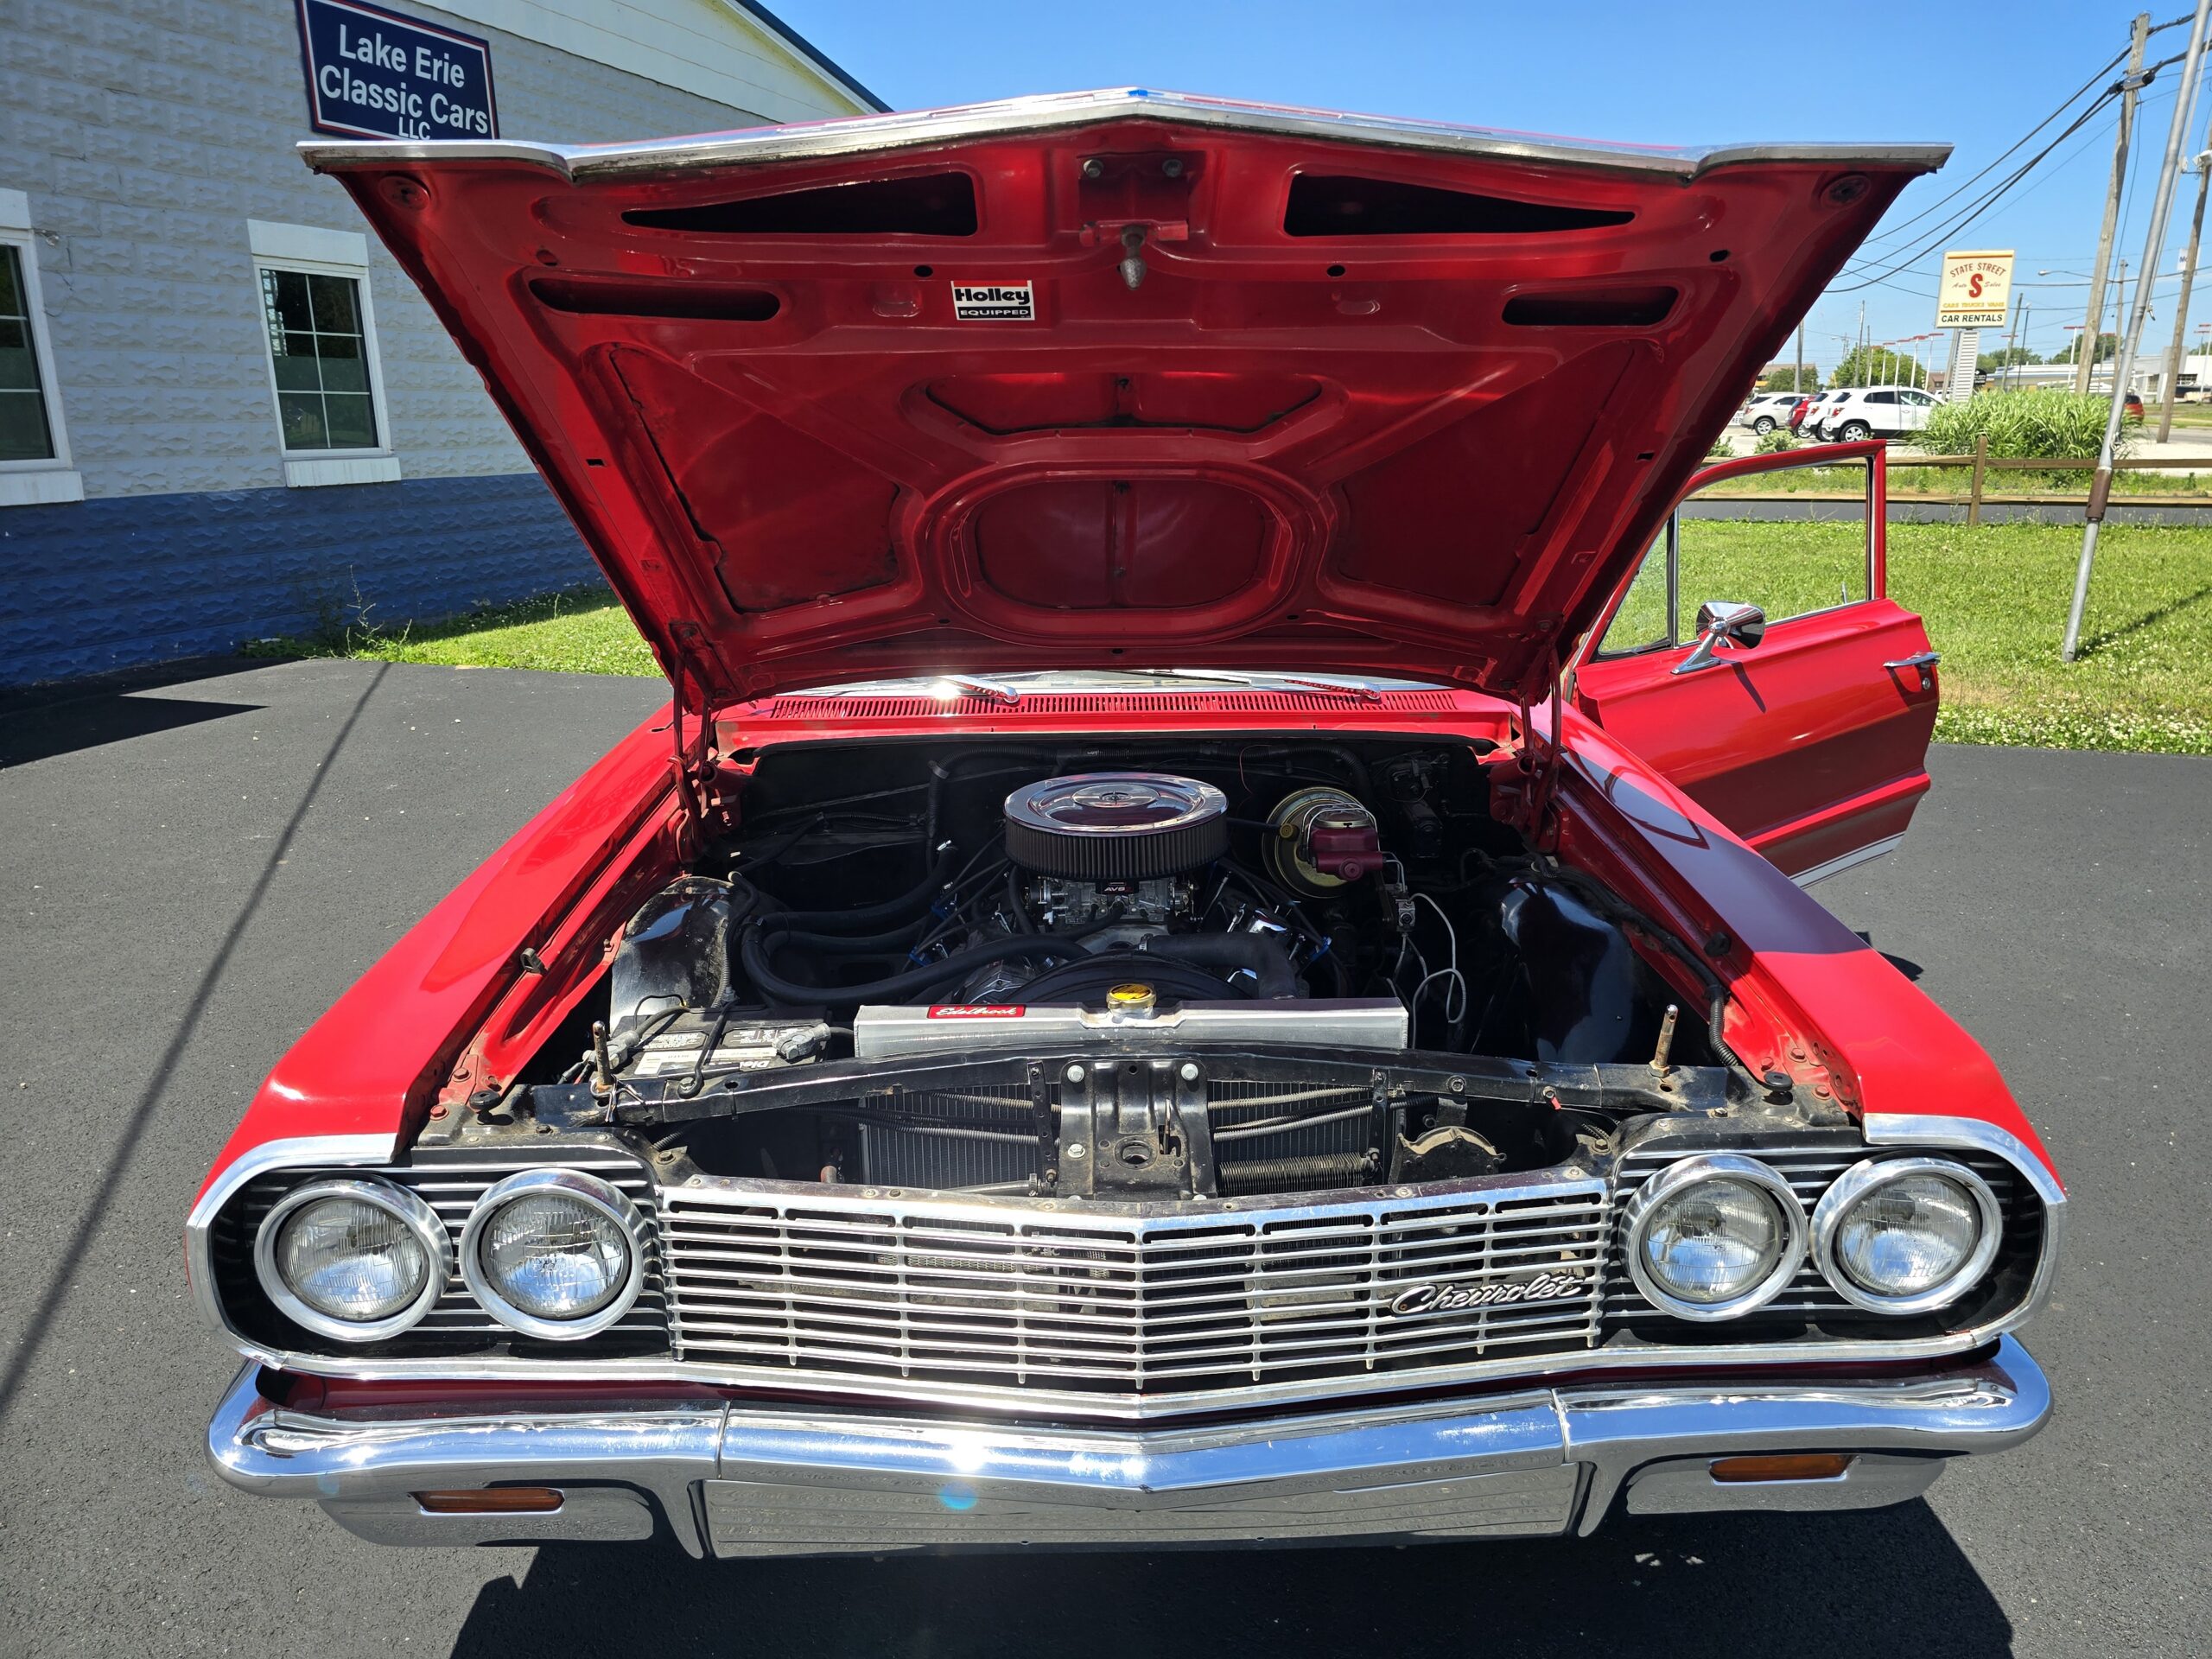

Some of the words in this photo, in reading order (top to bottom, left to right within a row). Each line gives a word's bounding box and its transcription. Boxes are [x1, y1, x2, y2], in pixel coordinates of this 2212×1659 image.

[340, 24, 406, 73] Lake
[416, 46, 465, 88] Erie
[320, 65, 423, 118] Classic
[430, 92, 488, 134] Cars
[398, 116, 430, 140] LLC
[1950, 264, 1974, 277] STATE
[1977, 263, 2006, 276] STREET
[955, 288, 1030, 305] Holley
[1968, 273, 1983, 298] S
[1942, 315, 1960, 323] CAR
[1961, 314, 2003, 322] RENTALS
[935, 1006, 1017, 1016] Edelbrock
[1390, 1273, 1584, 1314] Chevrolet
